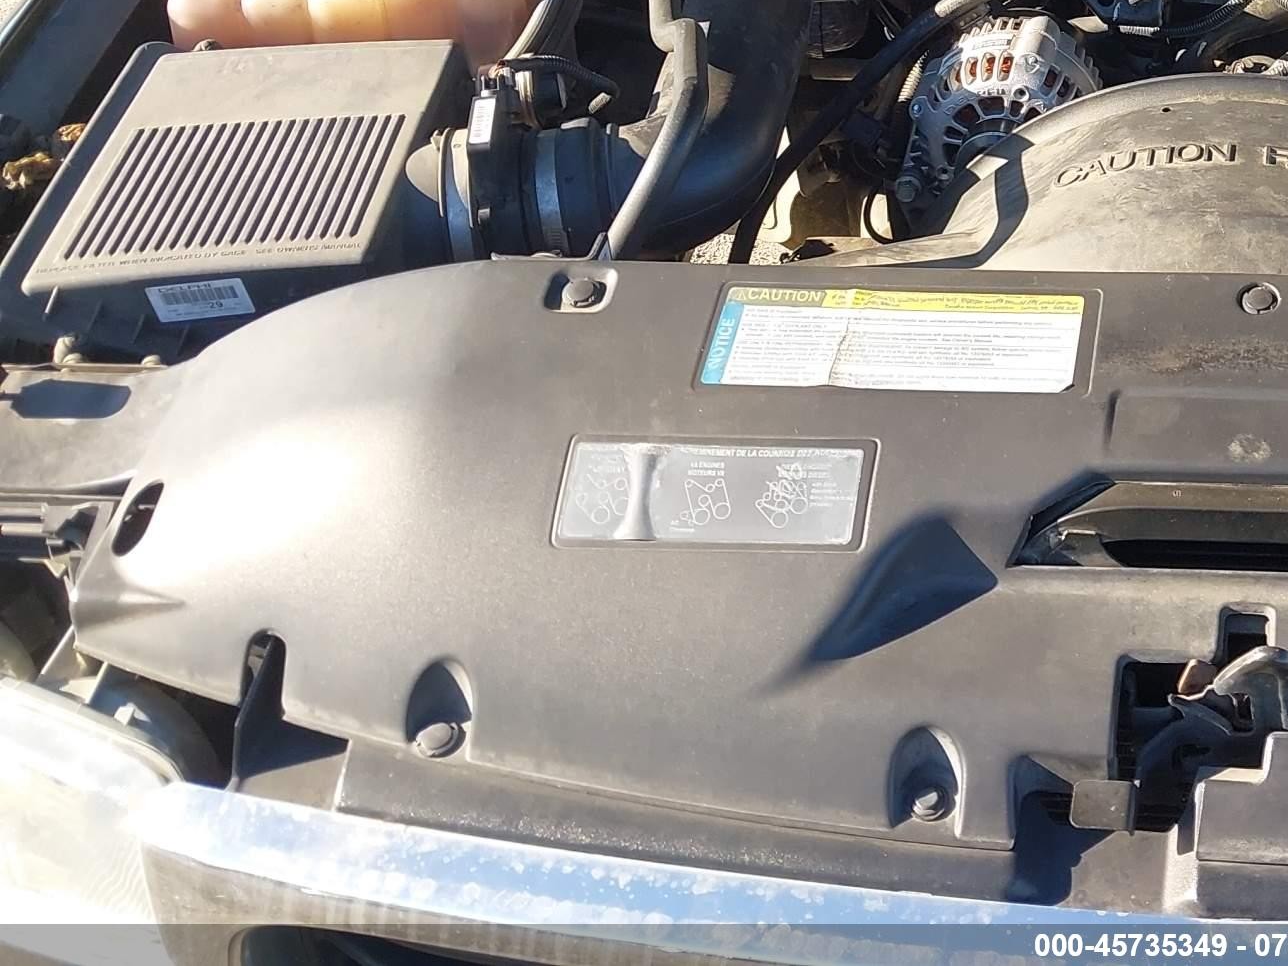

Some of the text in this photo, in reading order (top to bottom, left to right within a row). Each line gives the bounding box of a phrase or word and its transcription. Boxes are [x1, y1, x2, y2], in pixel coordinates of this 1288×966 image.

[1054, 143, 1237, 188] CAUTION
[119, 257, 148, 266] WHEN
[158, 282, 211, 293] DELPHI
[748, 288, 822, 302] CAUTION
[207, 300, 223, 309] 29
[707, 317, 736, 370] NOTICE
